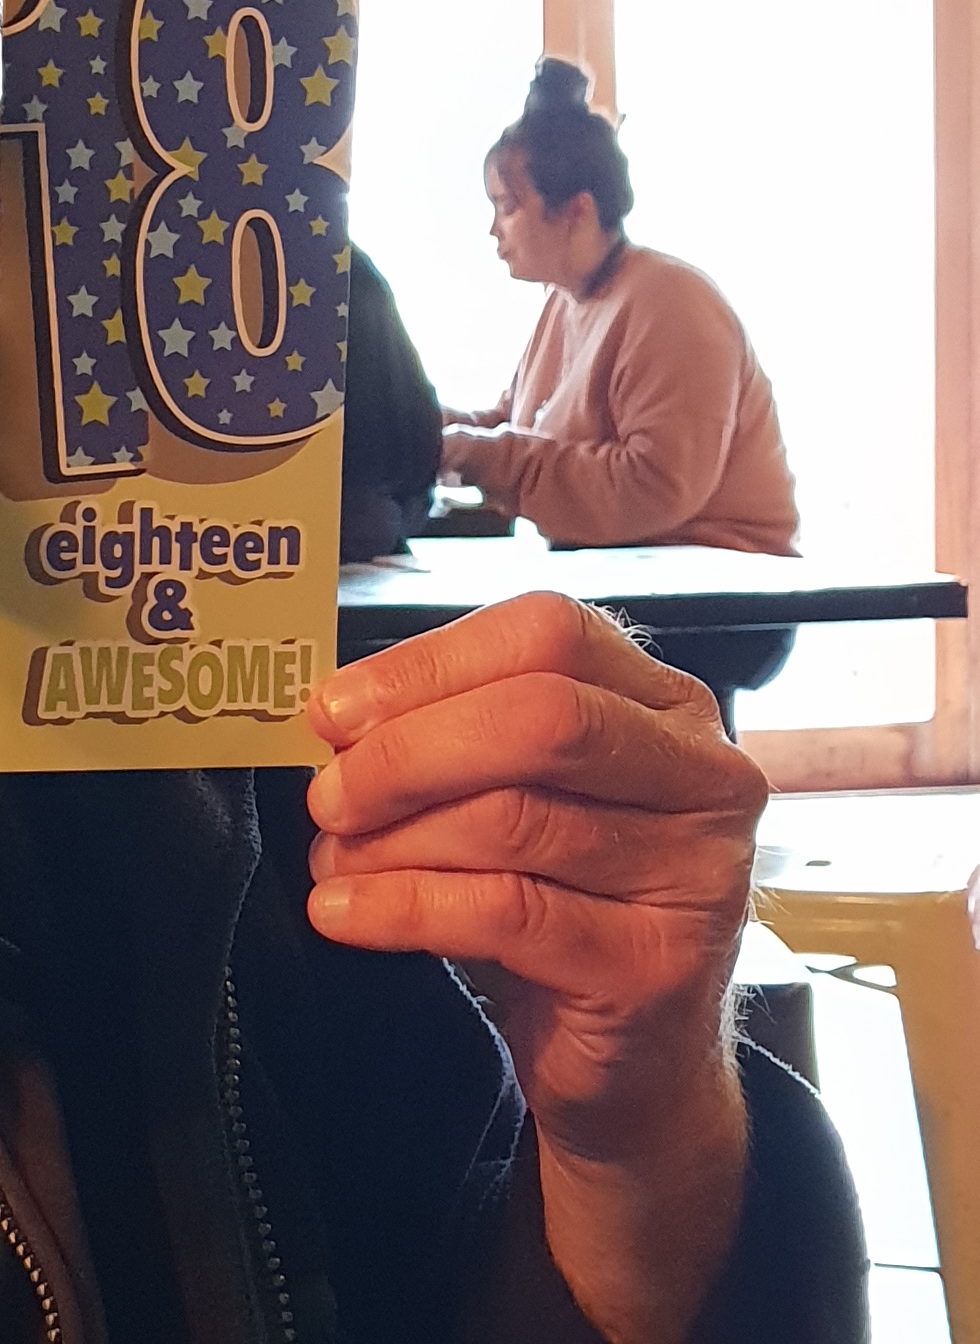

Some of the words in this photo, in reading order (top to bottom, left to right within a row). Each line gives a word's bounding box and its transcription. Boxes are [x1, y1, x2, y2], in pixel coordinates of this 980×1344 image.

[43, 506, 304, 590] eighteen
[146, 578, 196, 633] &
[42, 643, 315, 714] AWESOME!
